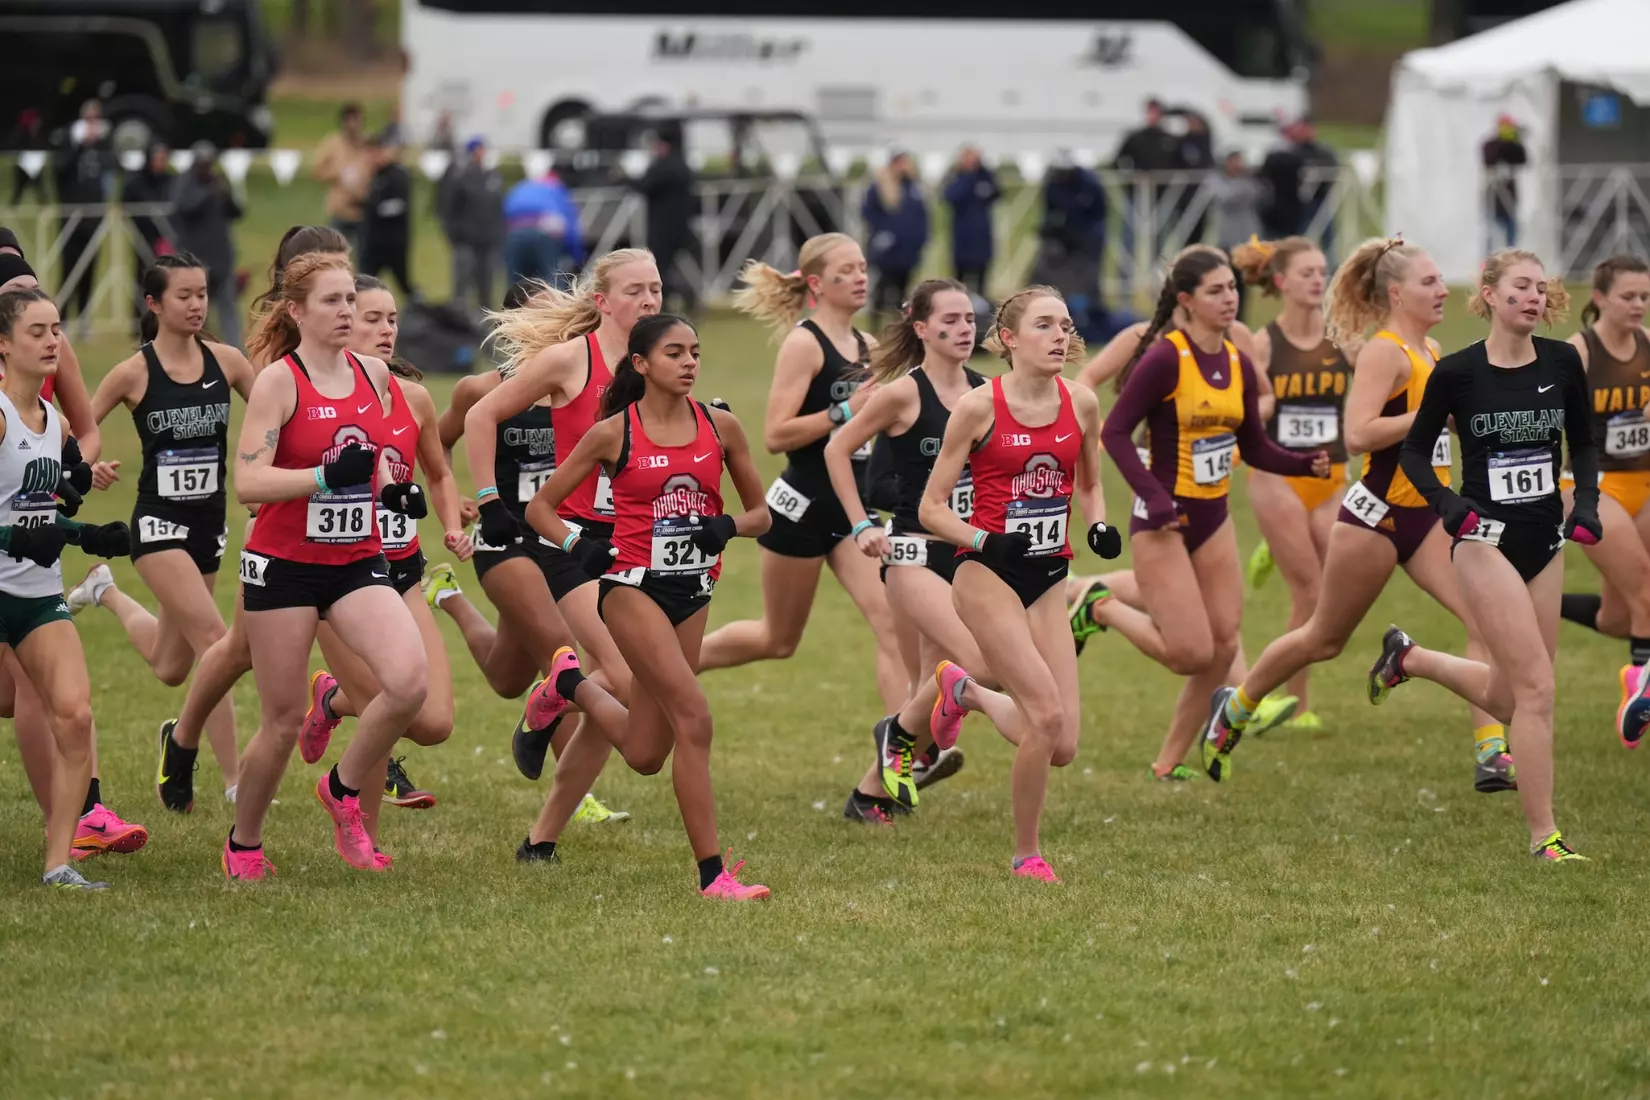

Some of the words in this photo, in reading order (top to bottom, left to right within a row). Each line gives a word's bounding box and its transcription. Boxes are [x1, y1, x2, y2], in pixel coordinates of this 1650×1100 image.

[1274, 371, 1345, 399] VALPO
[1594, 384, 1650, 413] VALP
[173, 420, 217, 440] STATE
[1289, 419, 1324, 437] 351
[1500, 426, 1550, 443] STATE
[1616, 427, 1649, 450] 348
[169, 468, 211, 491] 157
[1502, 467, 1543, 494] 161
[771, 486, 798, 512] 160
[1348, 489, 1377, 517] 141
[147, 519, 181, 536] 157
[318, 507, 363, 533] 318
[379, 514, 406, 538] 13
[240, 557, 258, 579] 18
